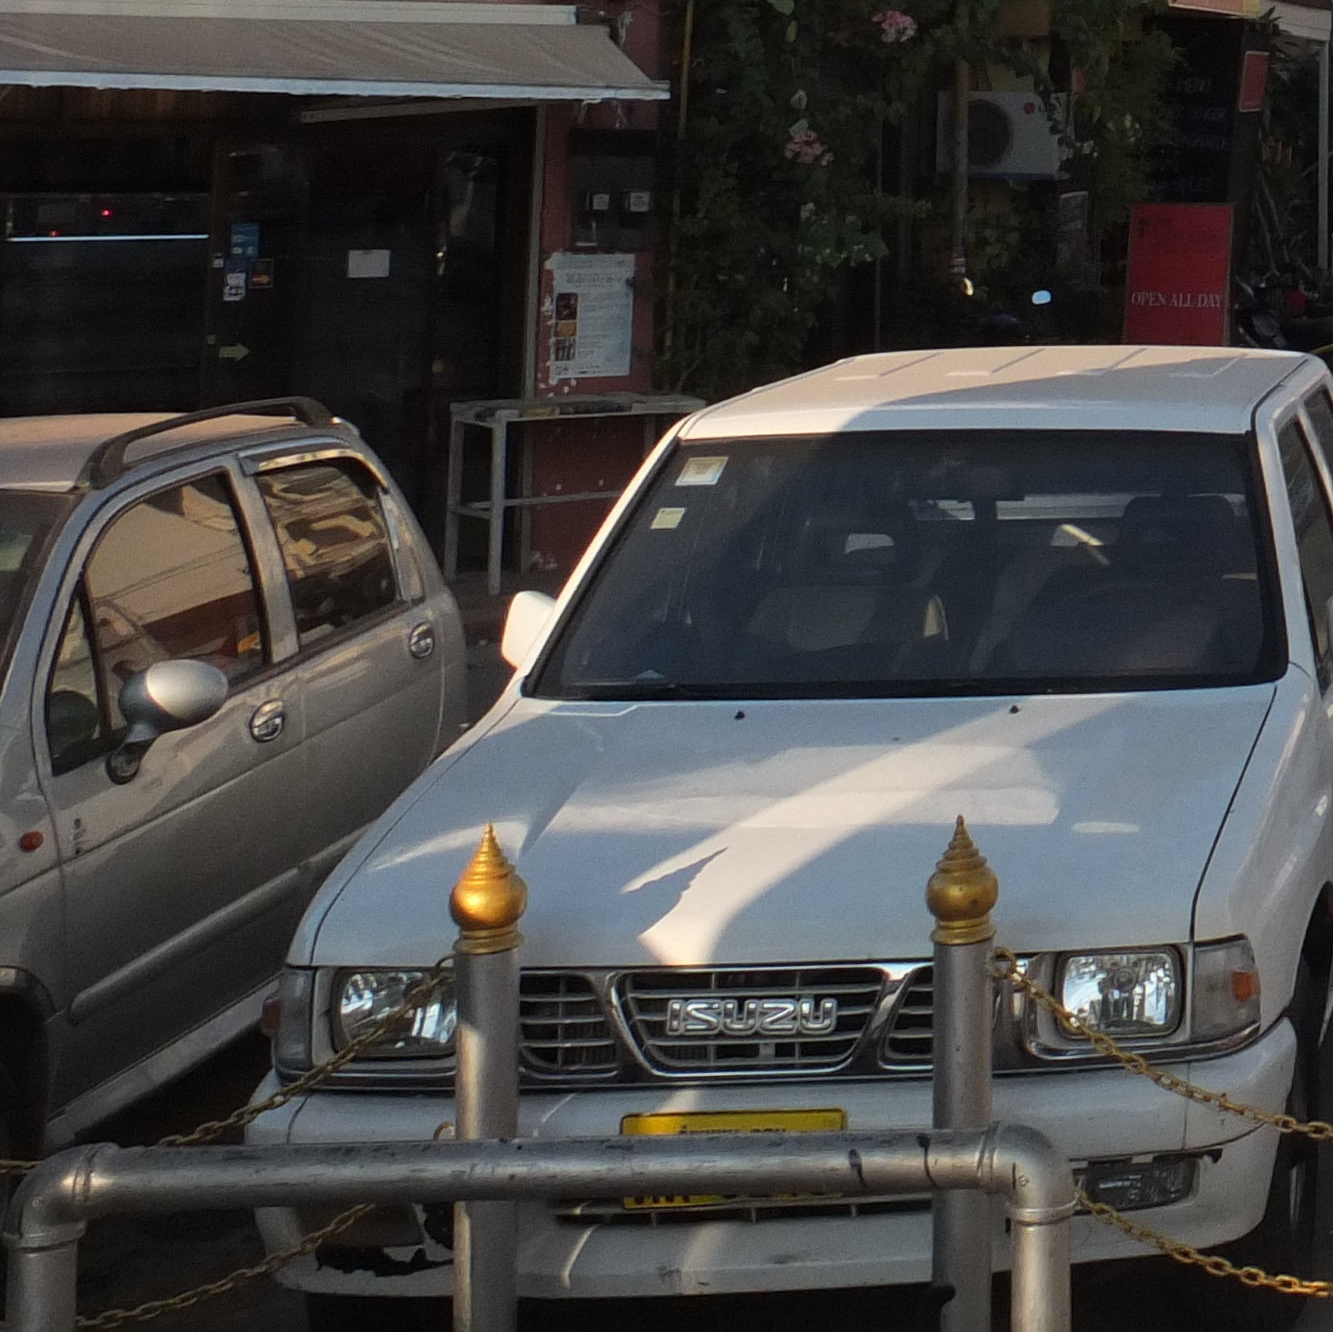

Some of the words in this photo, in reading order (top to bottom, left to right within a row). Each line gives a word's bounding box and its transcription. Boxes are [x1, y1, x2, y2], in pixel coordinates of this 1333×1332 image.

[1131, 291, 1167, 306] OPEN
[1171, 293, 1193, 307] ALL
[1197, 293, 1222, 308] DAY
[667, 998, 837, 1036] ISUZU
